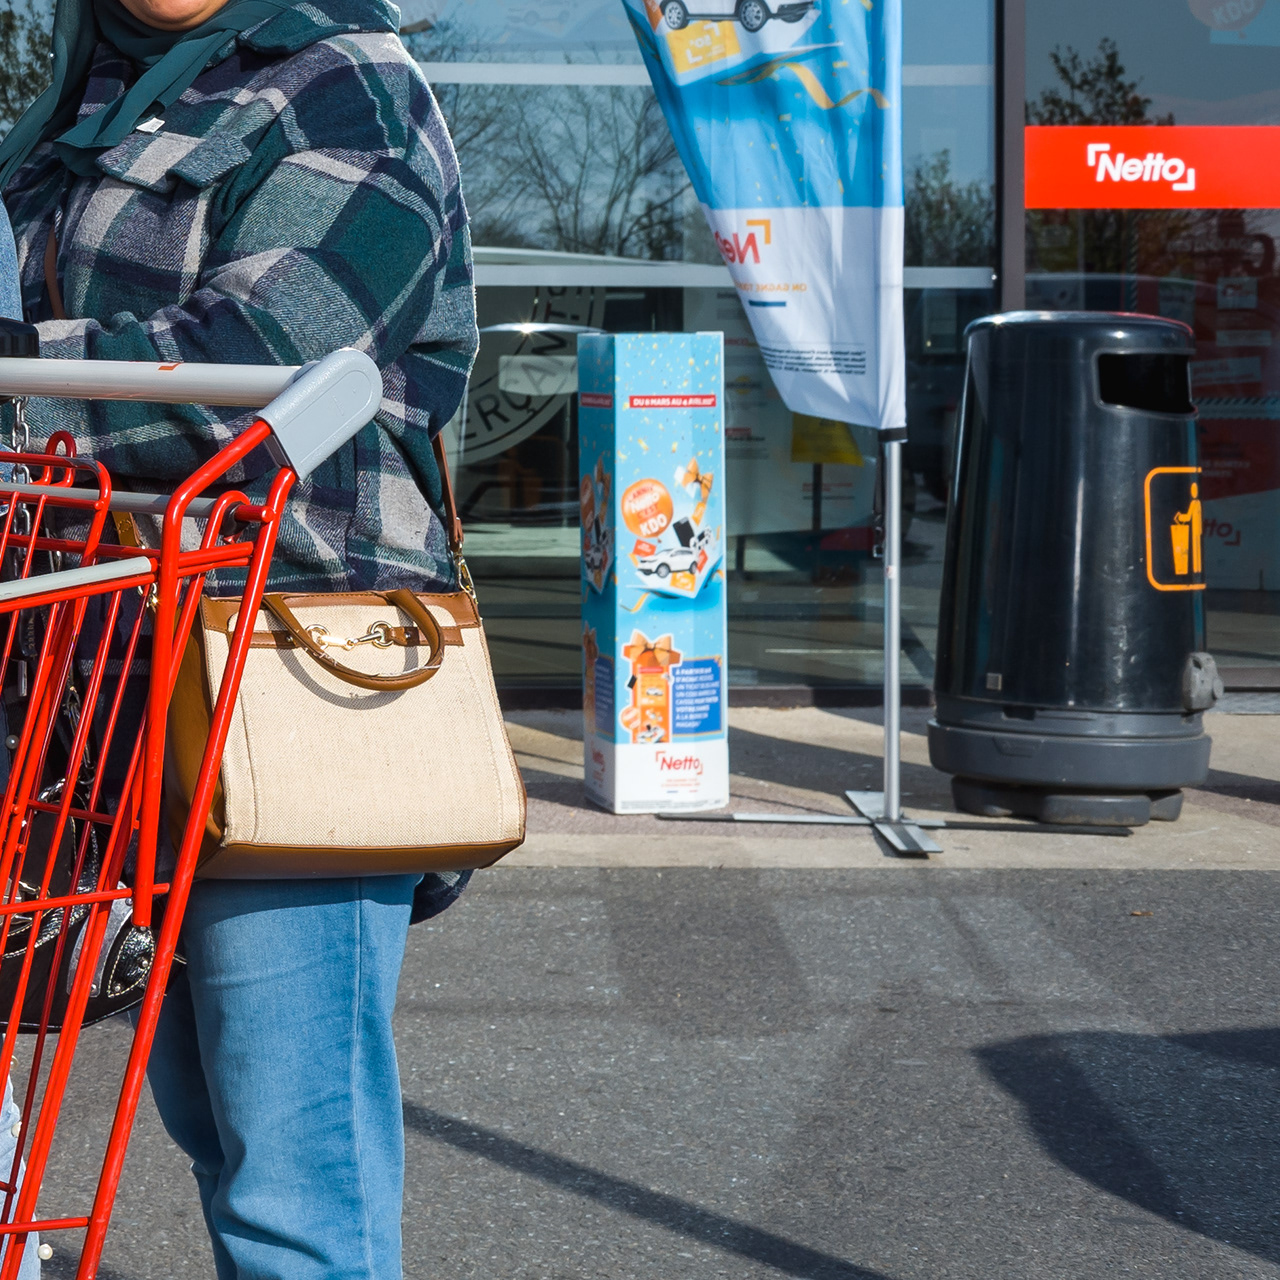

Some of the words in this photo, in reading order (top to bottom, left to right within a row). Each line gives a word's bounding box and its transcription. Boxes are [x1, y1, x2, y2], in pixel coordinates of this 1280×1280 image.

[1095, 152, 1185, 182] Netto
[639, 513, 668, 536] KDO
[660, 755, 700, 770] Netto
